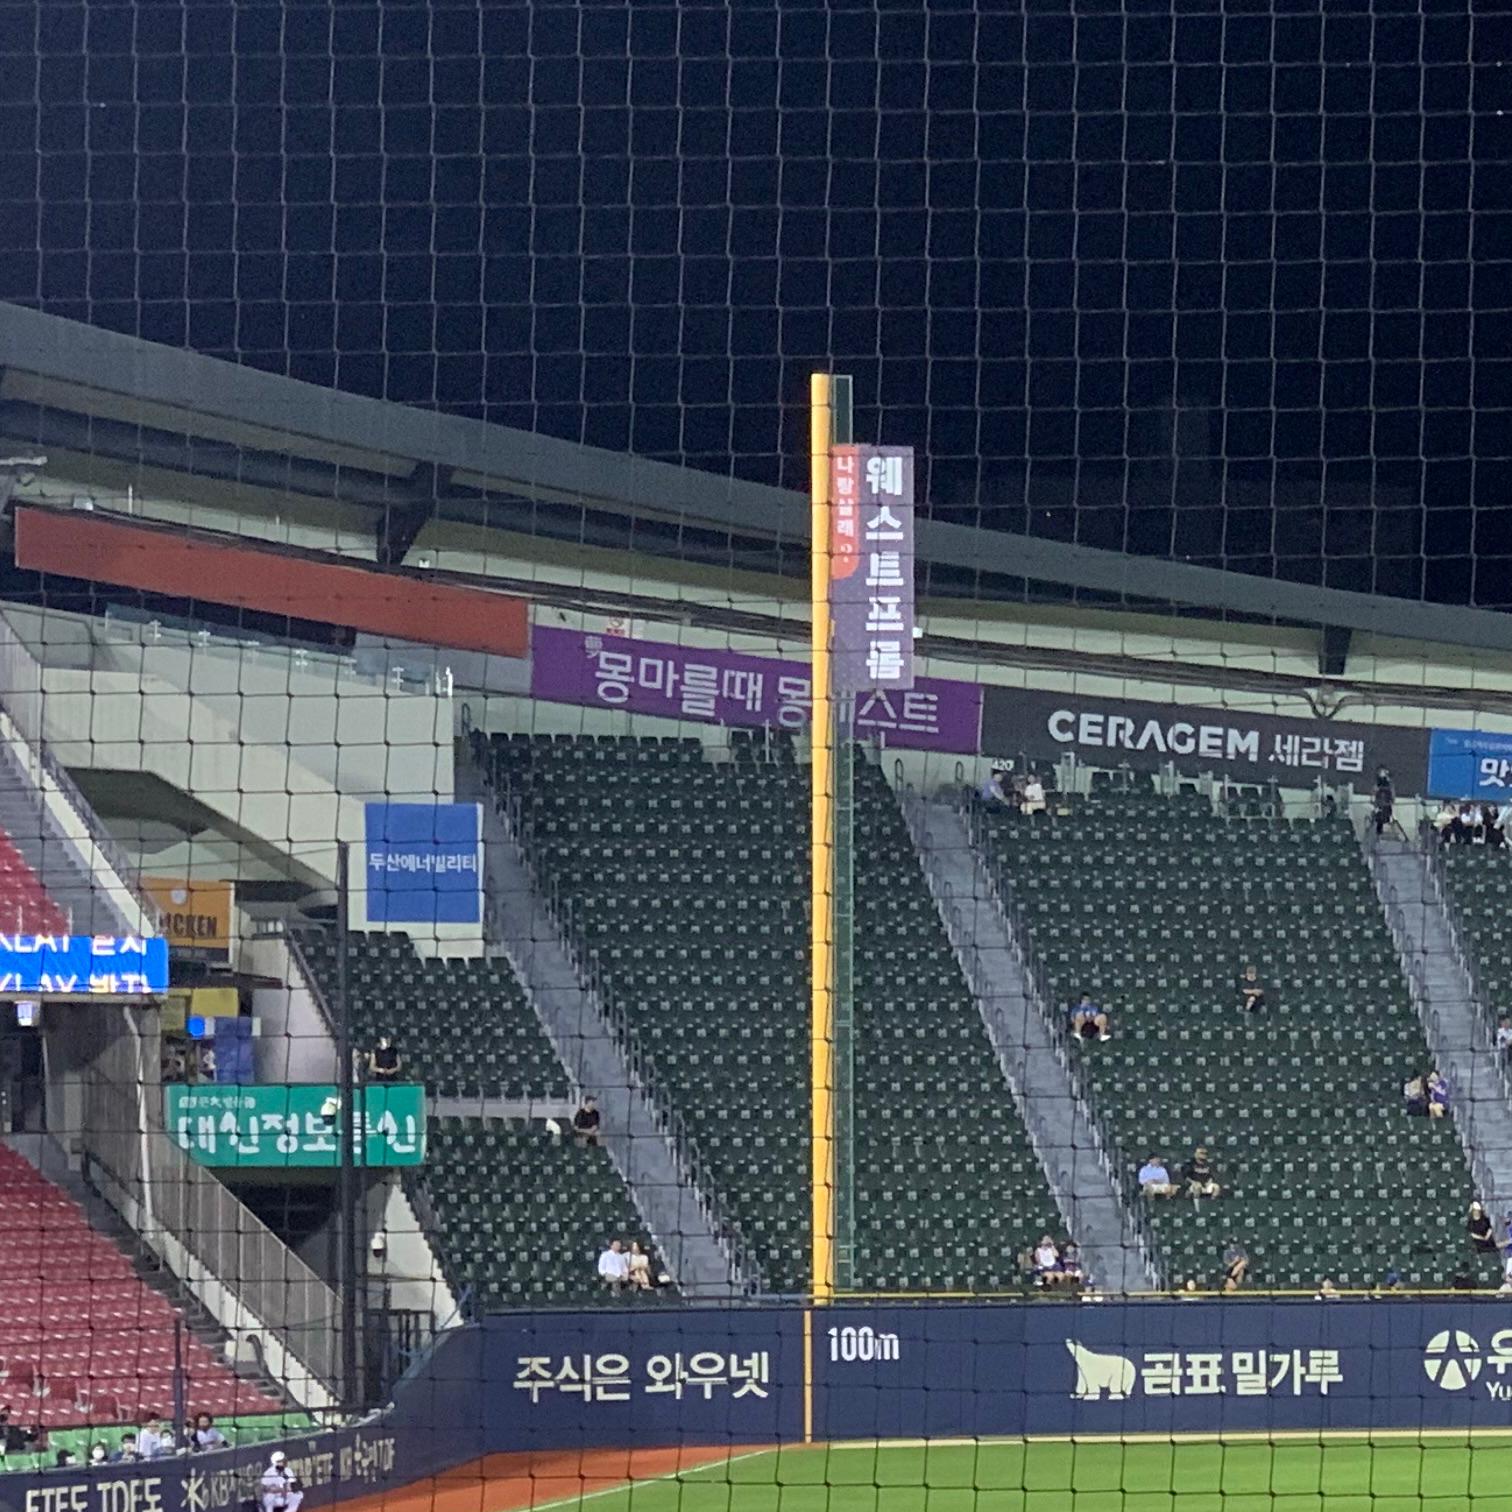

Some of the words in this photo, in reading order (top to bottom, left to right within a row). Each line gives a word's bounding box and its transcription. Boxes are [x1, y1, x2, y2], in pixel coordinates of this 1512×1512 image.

[595, 651, 763, 716] 몽마를때
[776, 676, 939, 734] 몽스트
[1048, 710, 1260, 762] CERAGEM
[1269, 734, 1364, 773] 세라젬
[369, 853, 477, 873] 두산에너빌리티
[829, 1327, 900, 1361] 100m
[513, 1353, 630, 1402] 주식은
[645, 1351, 769, 1400] 와우넷
